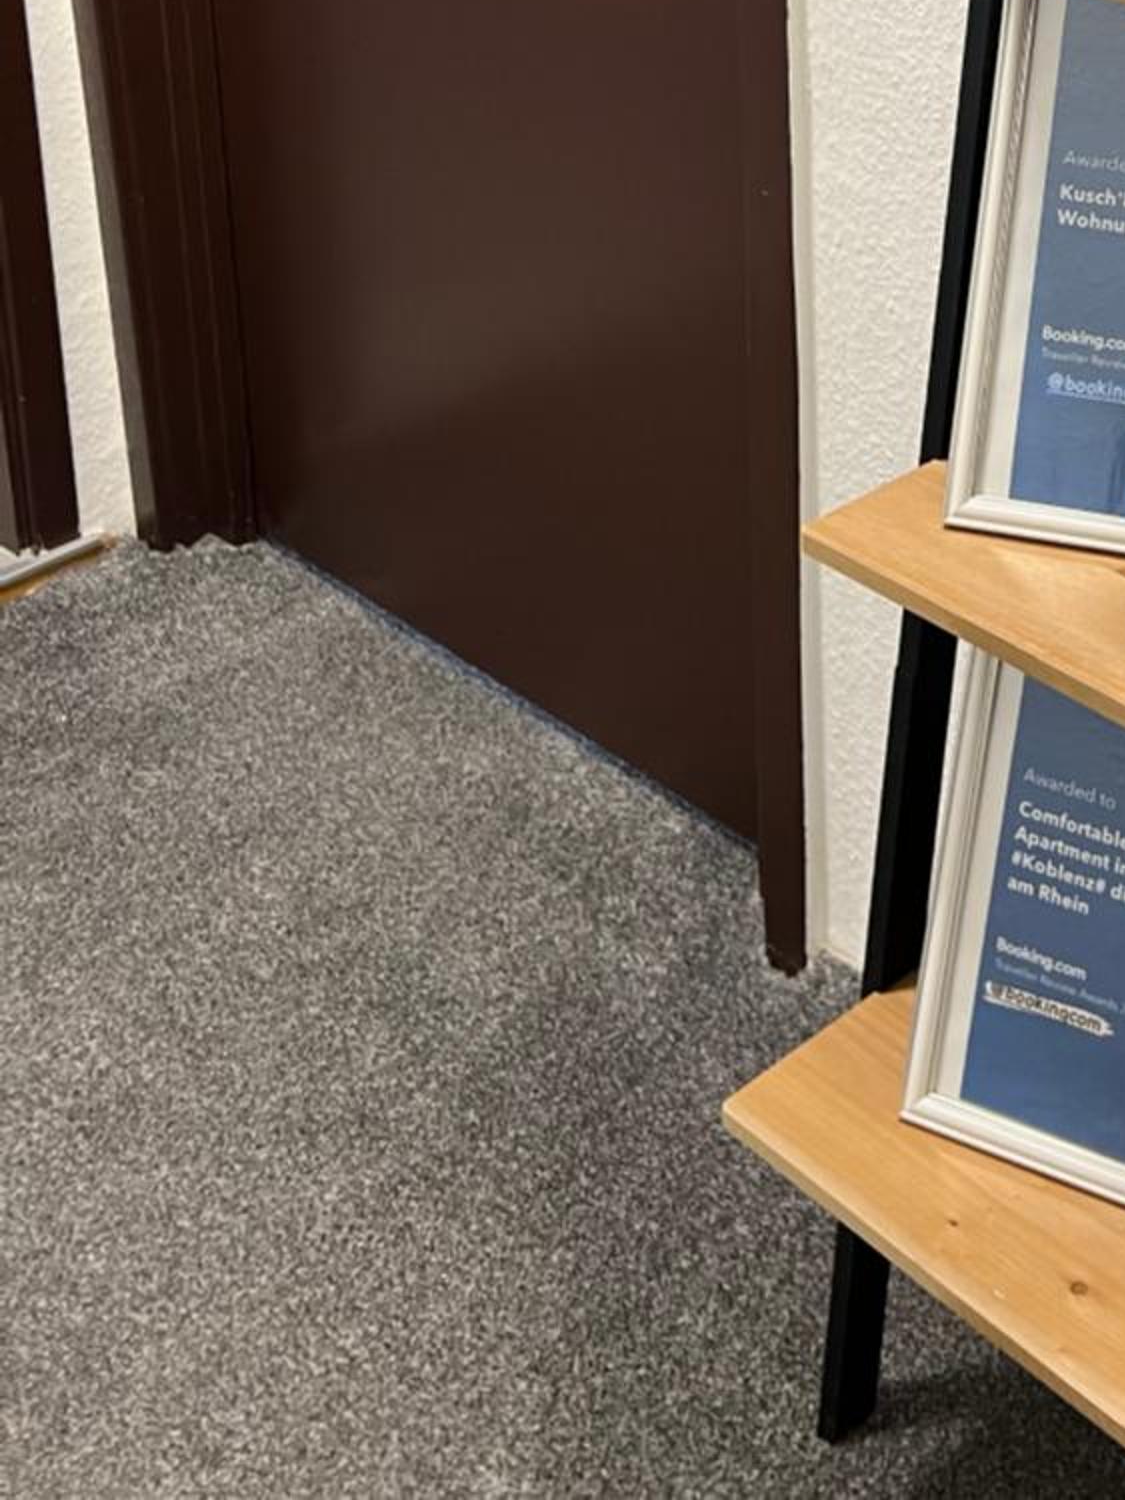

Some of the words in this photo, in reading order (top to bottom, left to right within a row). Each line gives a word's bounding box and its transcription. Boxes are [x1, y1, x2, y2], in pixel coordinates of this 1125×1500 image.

[1024, 767, 1097, 804] Awarded
[1100, 794, 1117, 811] to
[1014, 825, 1110, 872] Apartment
[1007, 876, 1034, 896] am
[1038, 883, 1090, 916] Rhein
[996, 935, 1087, 982] Booking.com
